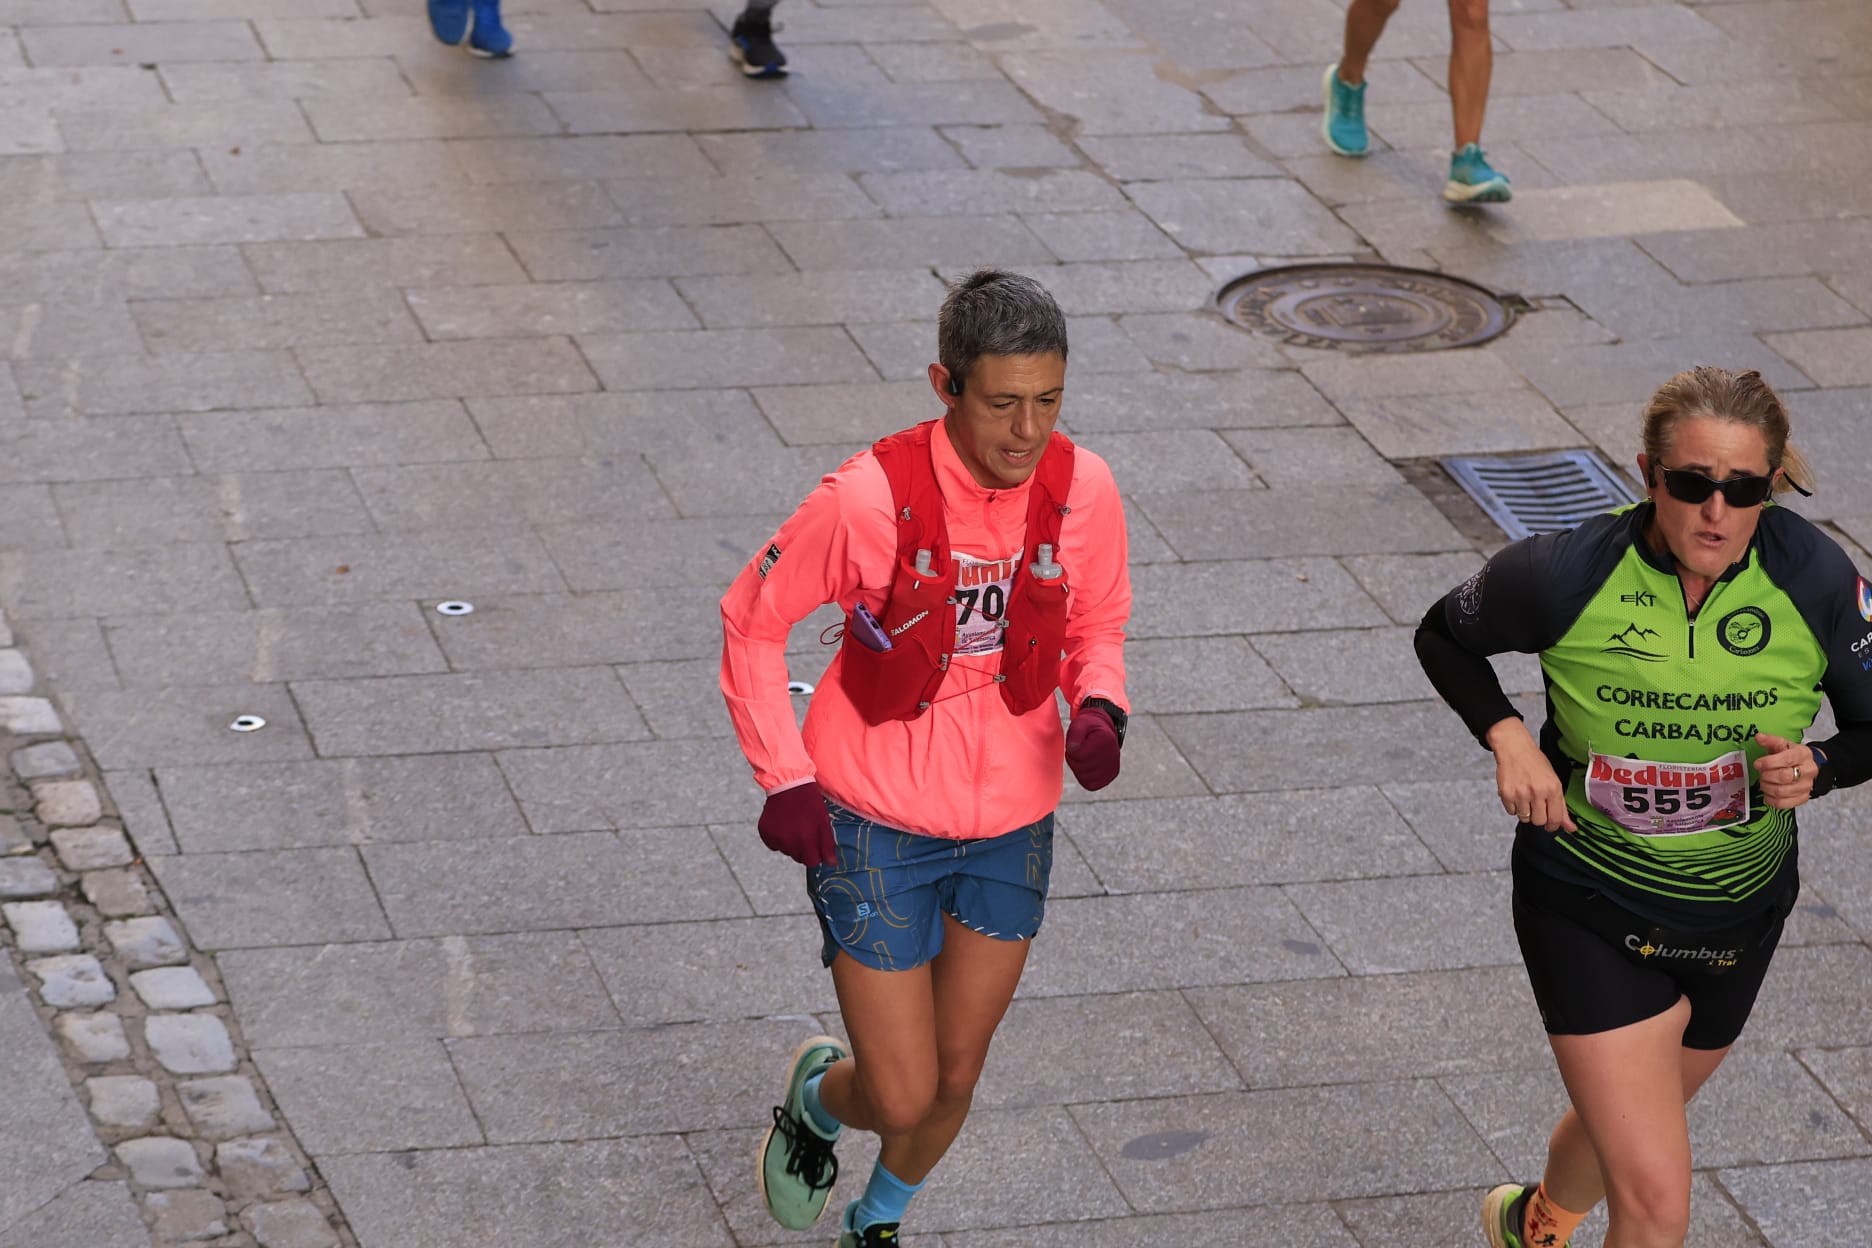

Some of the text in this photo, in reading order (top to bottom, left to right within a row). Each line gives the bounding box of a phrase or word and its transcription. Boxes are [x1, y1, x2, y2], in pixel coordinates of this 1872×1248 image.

[1620, 590, 1657, 607] EKT
[1596, 684, 1778, 711] CORRECAMINOS
[1614, 718, 1760, 745] CARBAJOSA
[1622, 785, 1712, 815] 555
